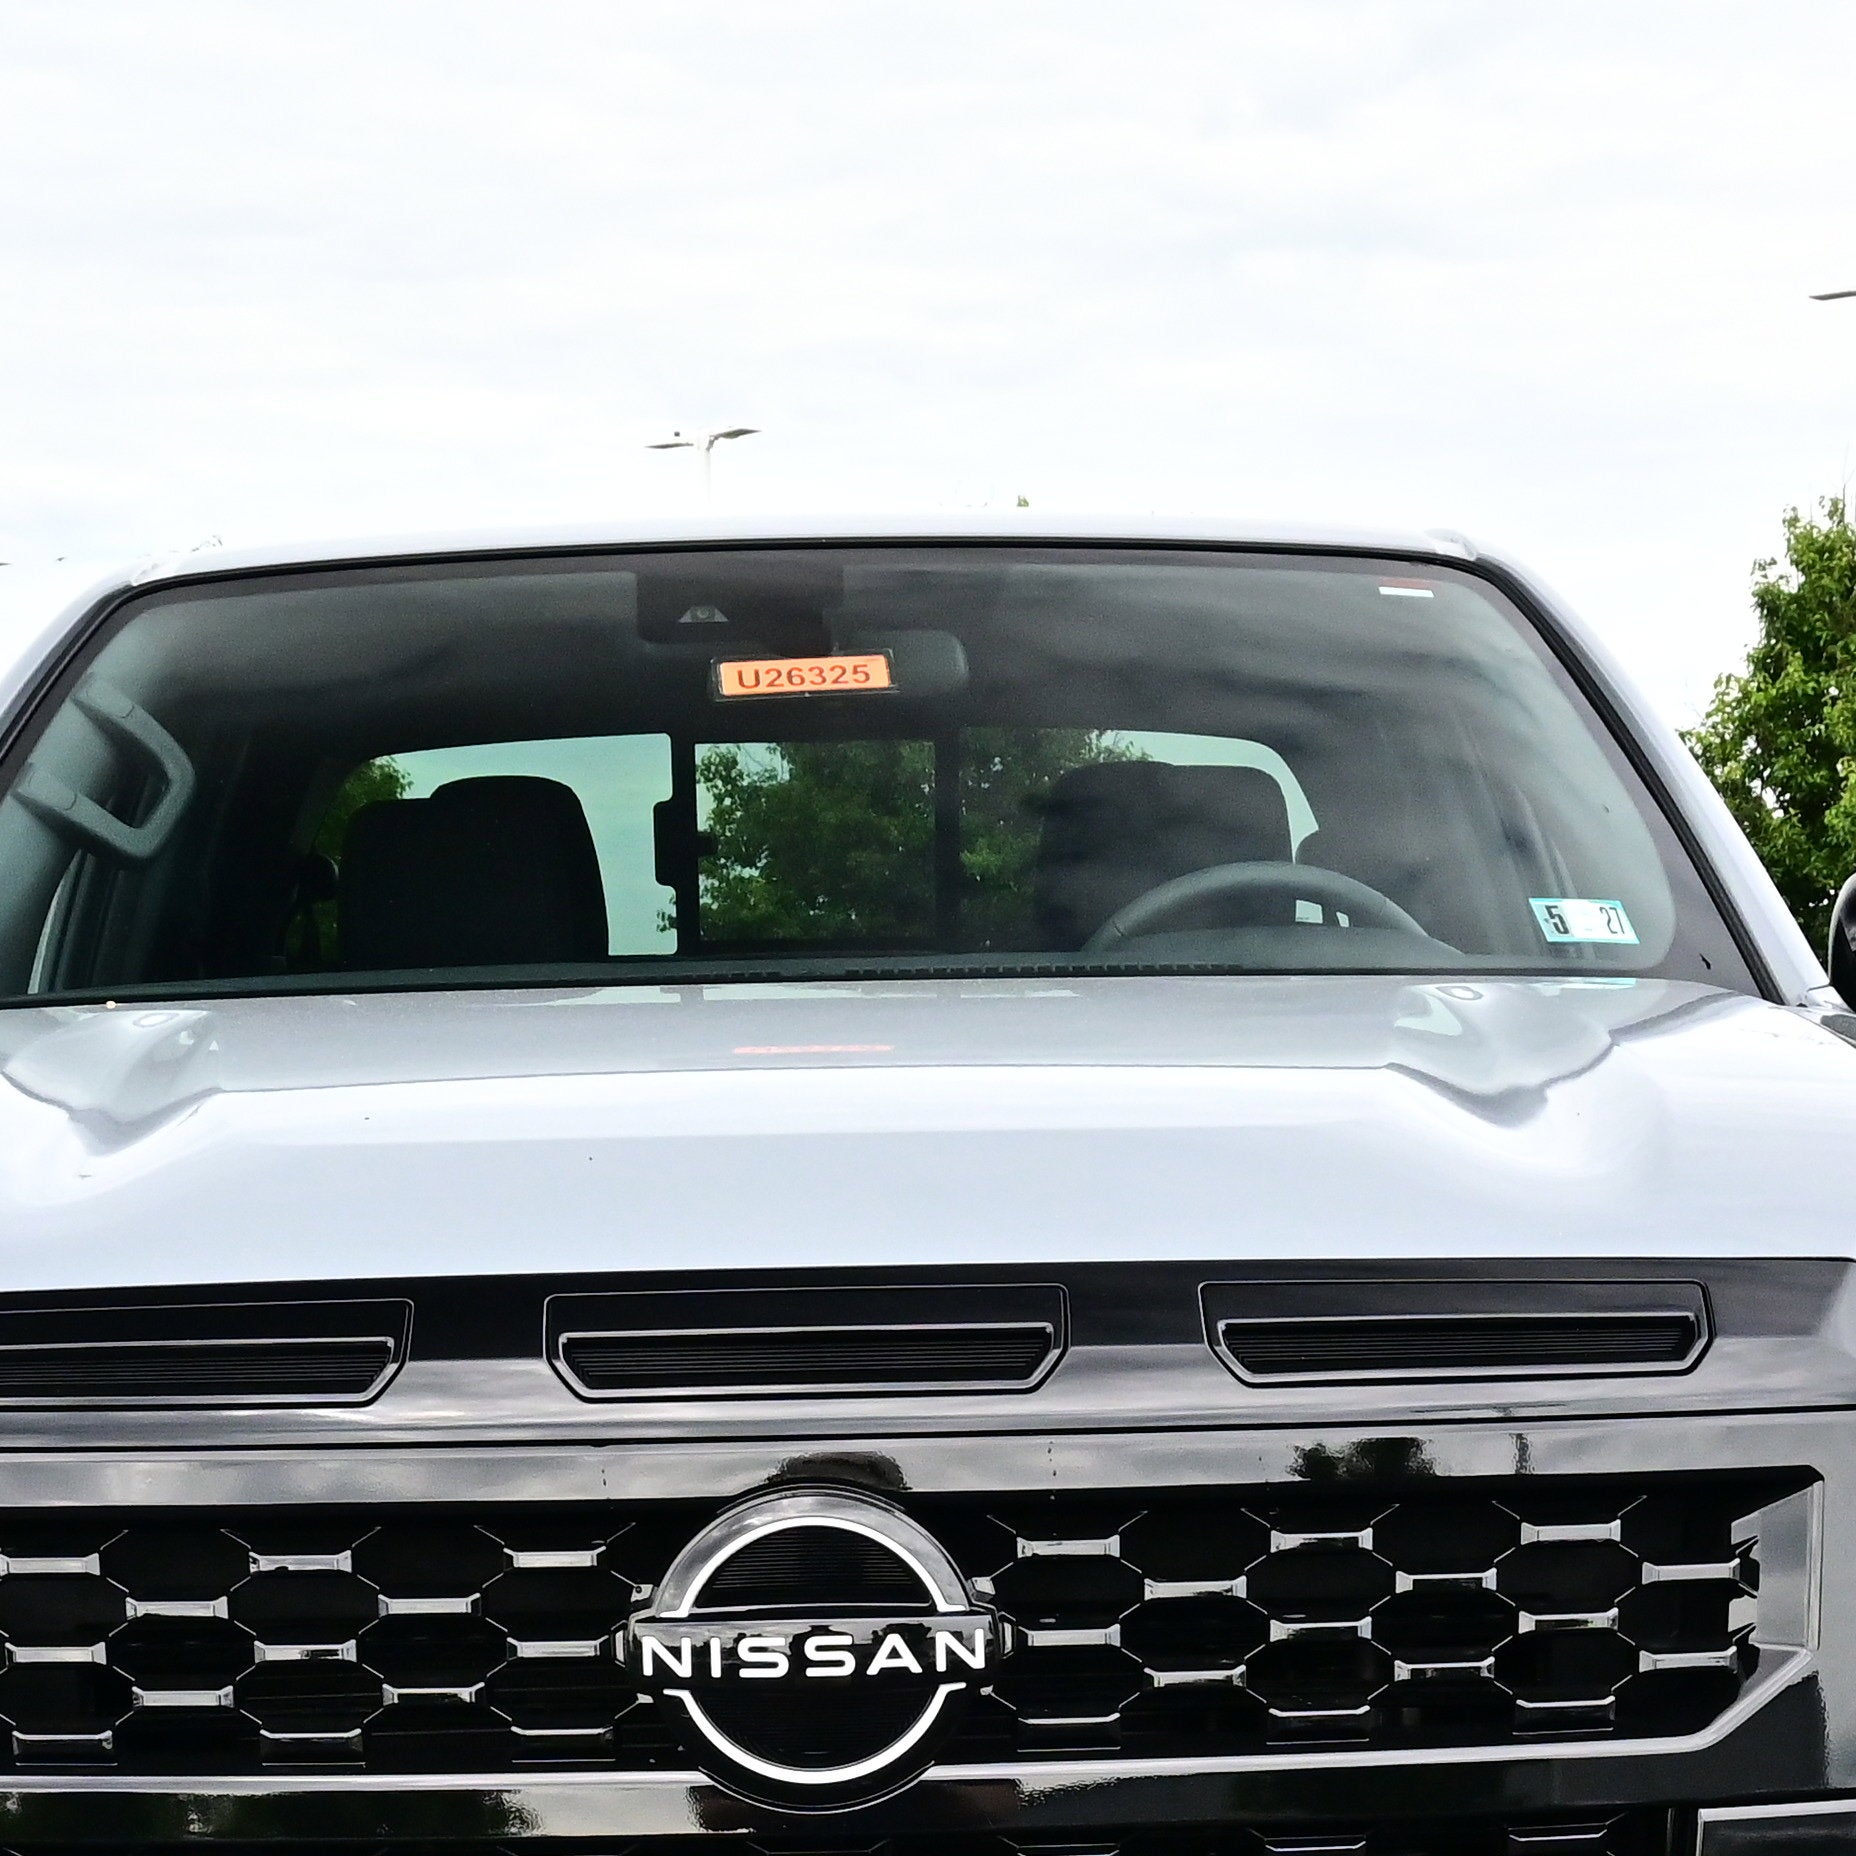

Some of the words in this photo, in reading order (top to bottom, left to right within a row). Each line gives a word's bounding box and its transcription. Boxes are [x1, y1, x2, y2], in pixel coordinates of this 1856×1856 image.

[737, 664, 871, 689] U26325
[1545, 905, 1570, 935] 5
[1599, 907, 1625, 934] 27
[642, 1628, 986, 1678] NISSAN
